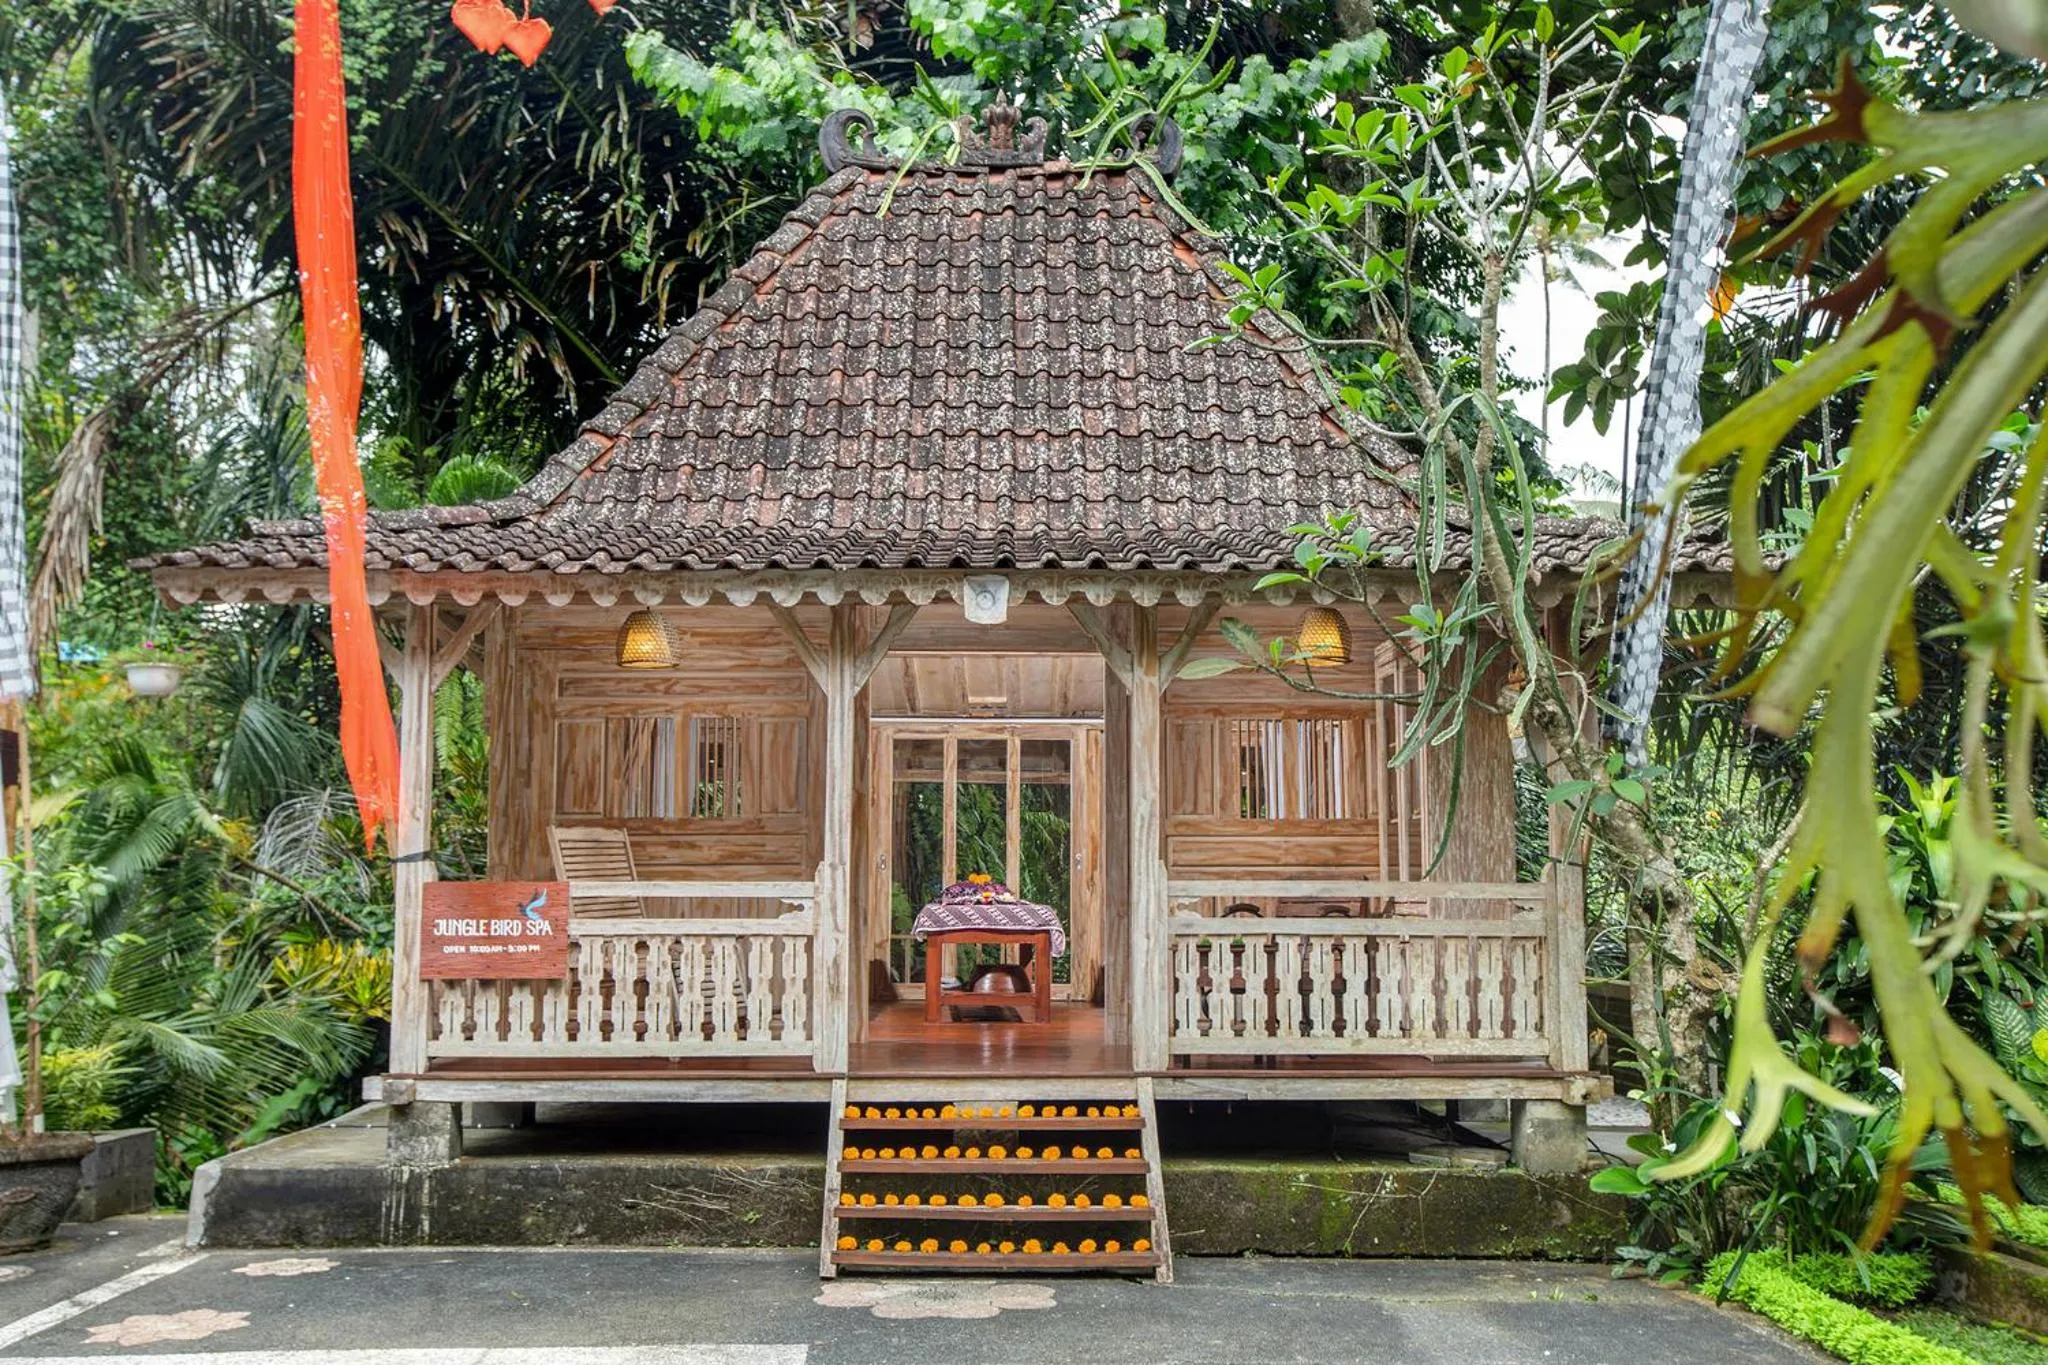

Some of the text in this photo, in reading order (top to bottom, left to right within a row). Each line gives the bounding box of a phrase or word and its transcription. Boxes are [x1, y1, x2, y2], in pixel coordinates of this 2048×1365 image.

[434, 919, 553, 936] JUNGLE BIRD SPA
[443, 945, 465, 954] OPEN
